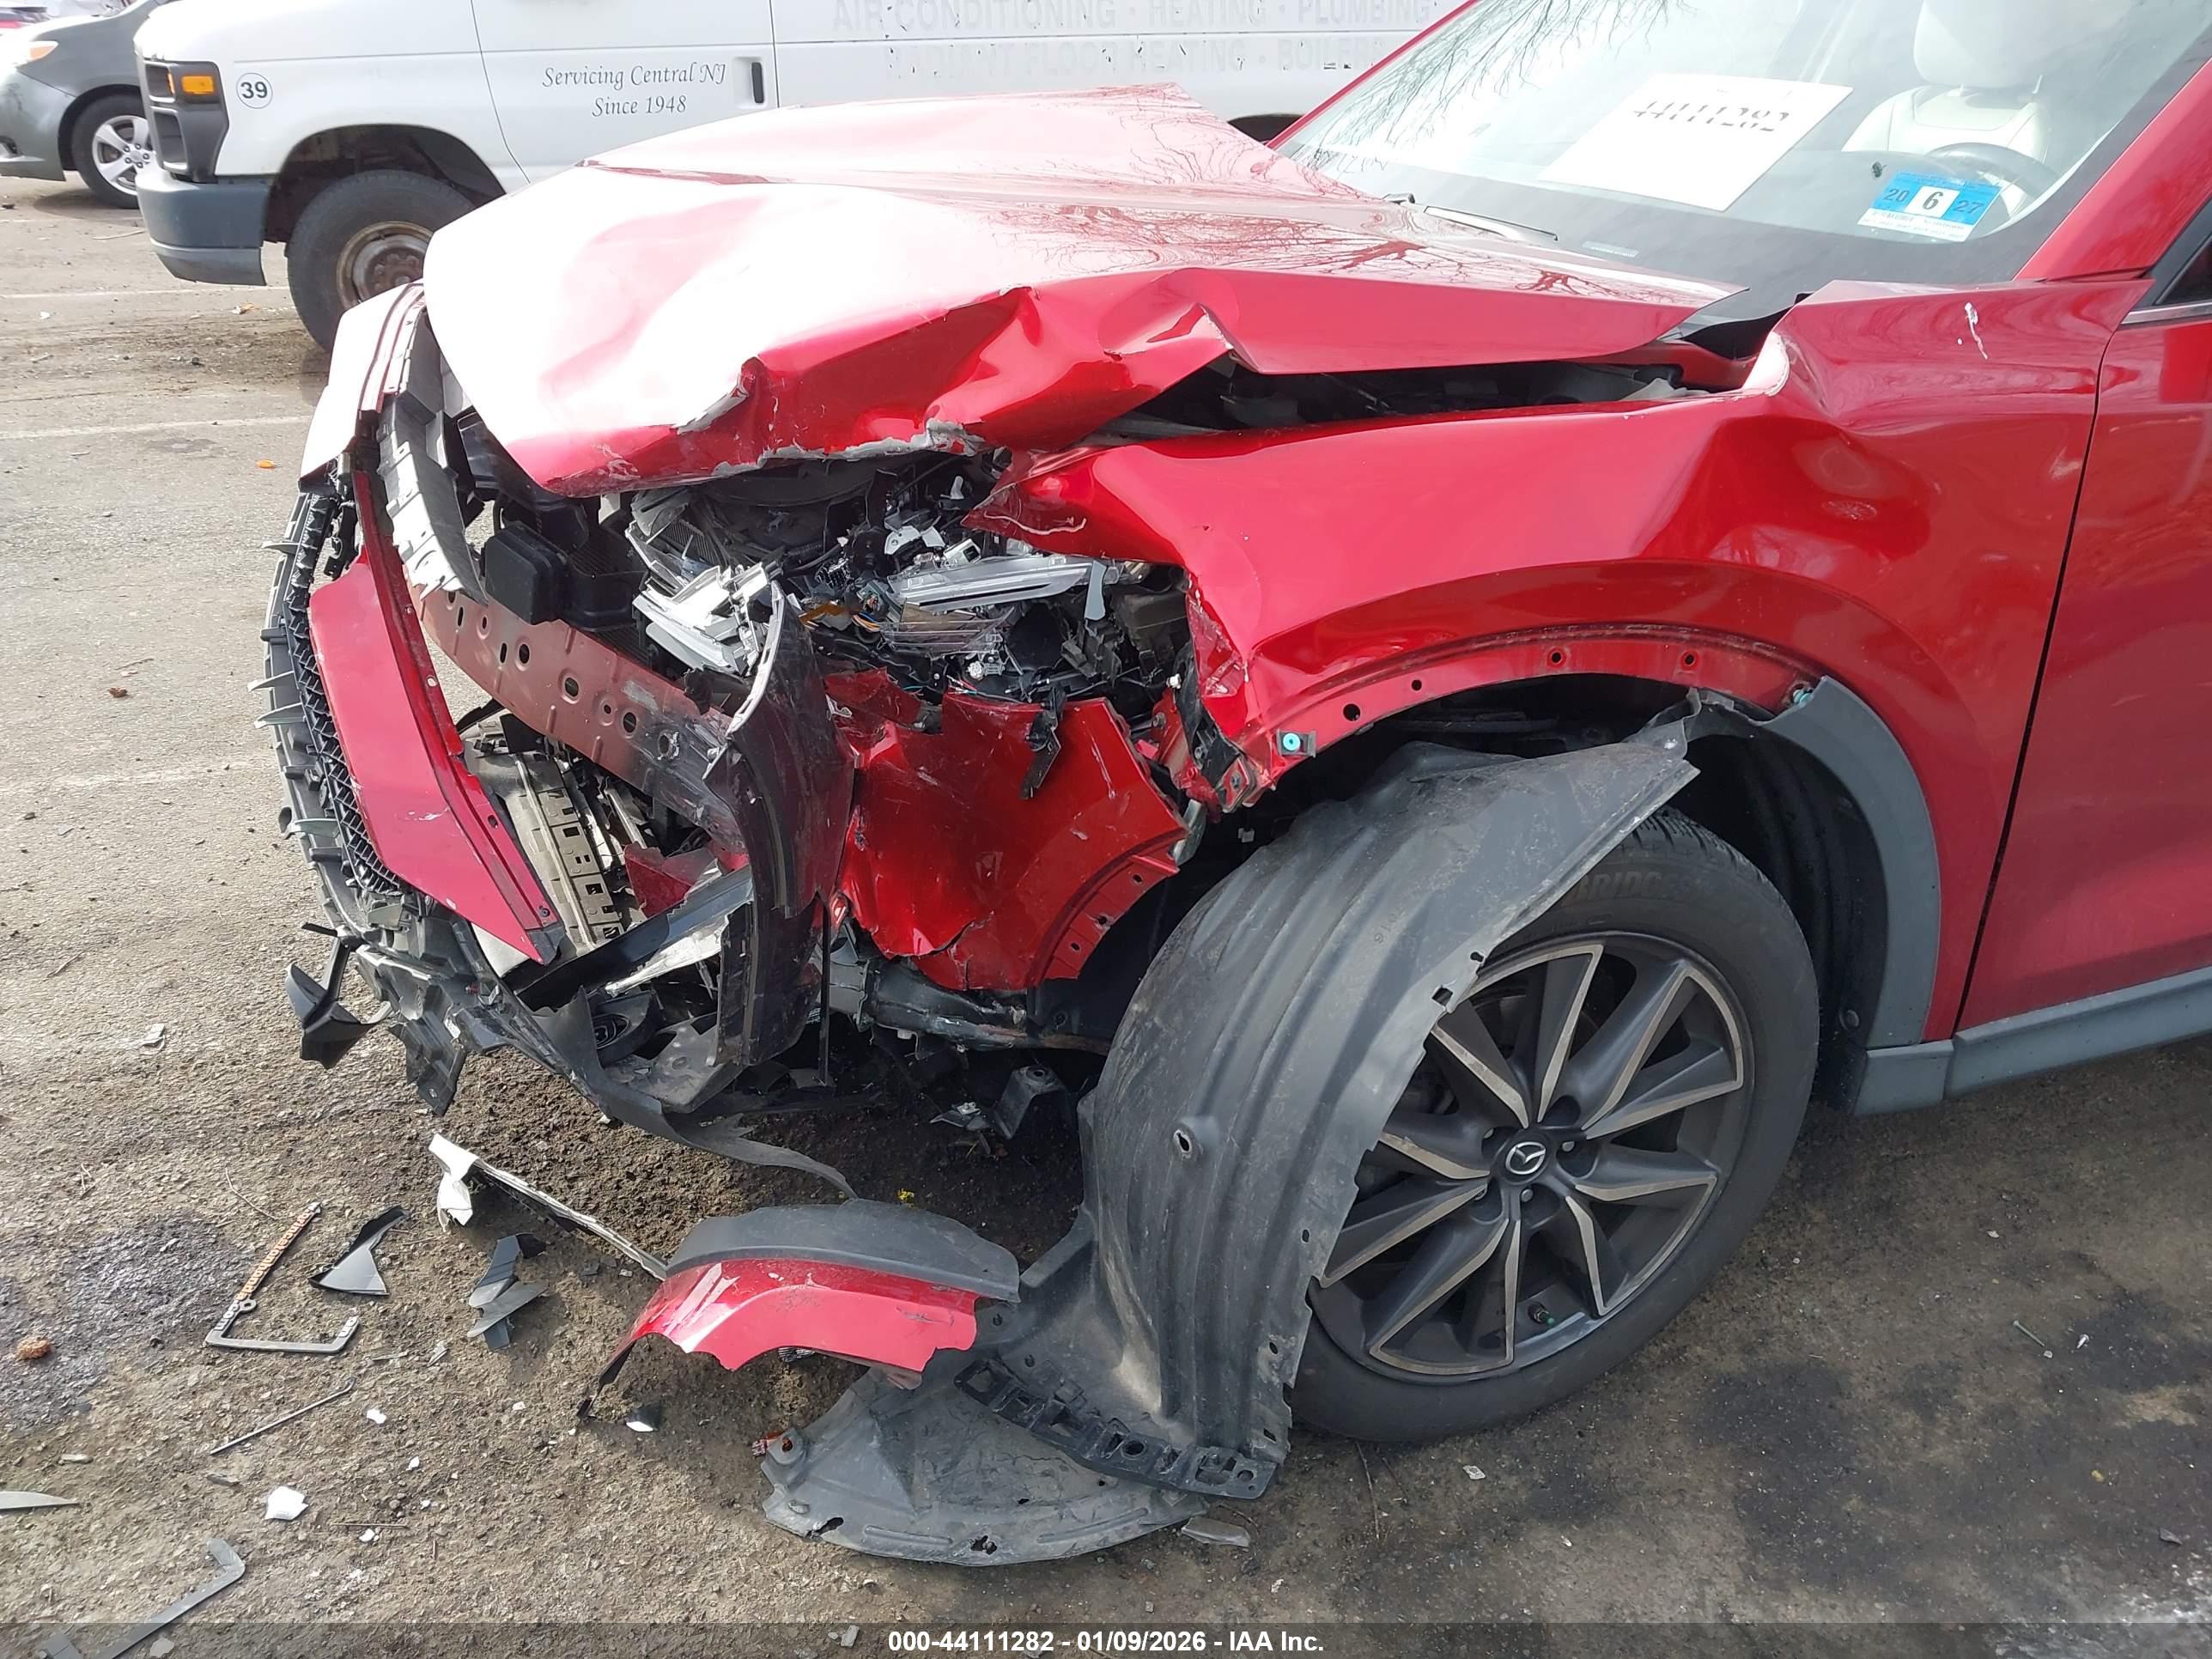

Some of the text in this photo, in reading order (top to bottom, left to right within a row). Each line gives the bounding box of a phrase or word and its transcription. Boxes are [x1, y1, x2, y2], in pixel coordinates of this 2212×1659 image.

[831, 0, 885, 32] AIR
[895, 0, 1118, 31] CONDITIONING
[1149, 0, 1267, 27] HEATING
[542, 62, 726, 91] Servicing Central NJ
[240, 81, 268, 100] 39
[591, 94, 688, 118] Since 1948
[1884, 188, 1984, 215] 20 6 27
